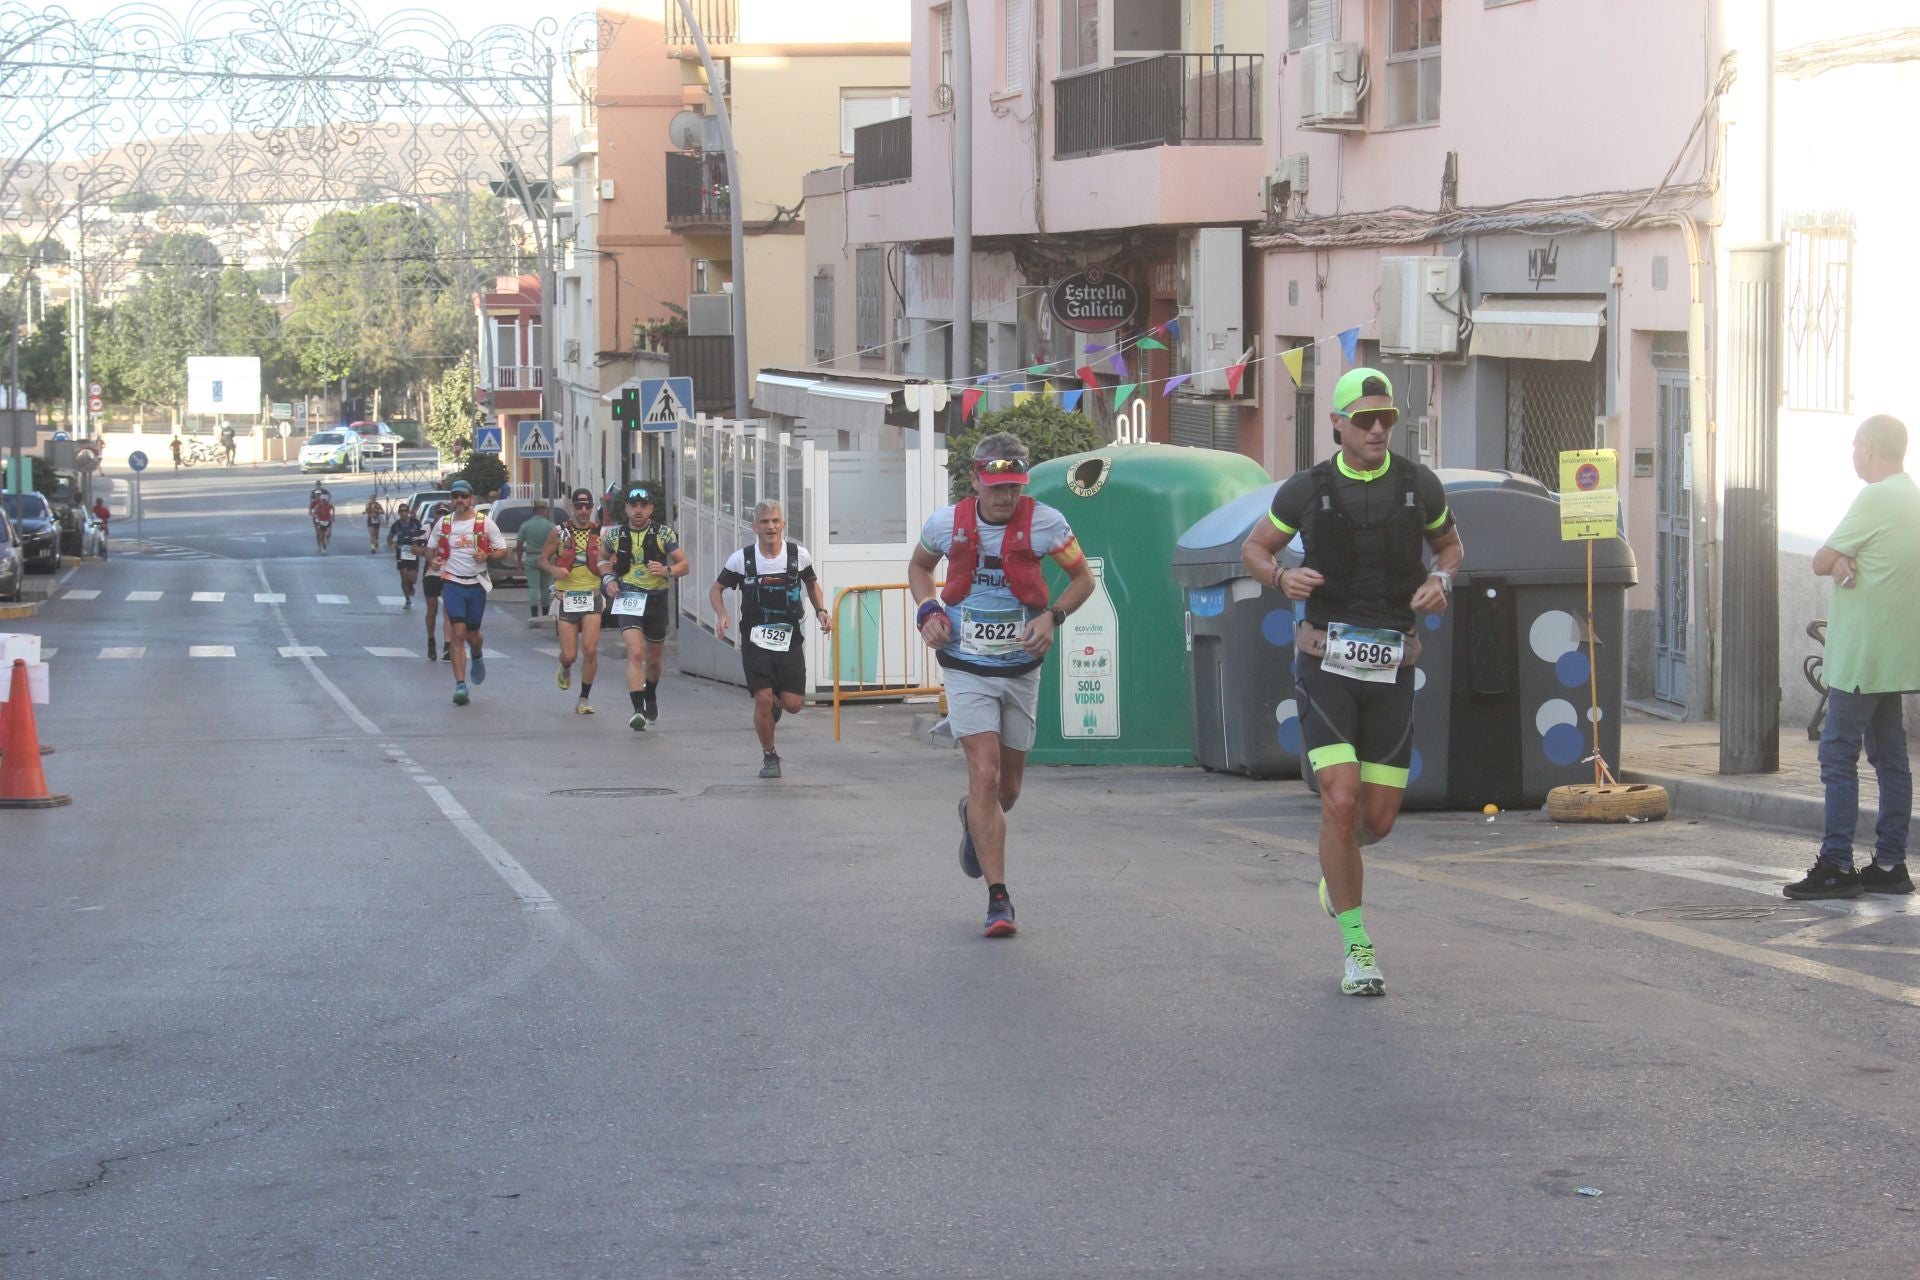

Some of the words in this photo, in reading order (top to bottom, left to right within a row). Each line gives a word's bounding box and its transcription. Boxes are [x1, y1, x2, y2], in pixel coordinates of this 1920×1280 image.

[1064, 284, 1126, 300] Estrella
[1066, 300, 1124, 317] Galicia
[1069, 482, 1077, 492] DE
[1080, 481, 1103, 496] VIDRIO
[573, 596, 588, 605] 552
[623, 598, 638, 608] 669
[974, 623, 1016, 640] 2622
[1074, 624, 1104, 632] ecovidrio
[761, 629, 786, 642] 1529
[1344, 641, 1392, 665] 3696
[1077, 680, 1101, 692] SOLO
[1074, 693, 1105, 705] VIDRIO
